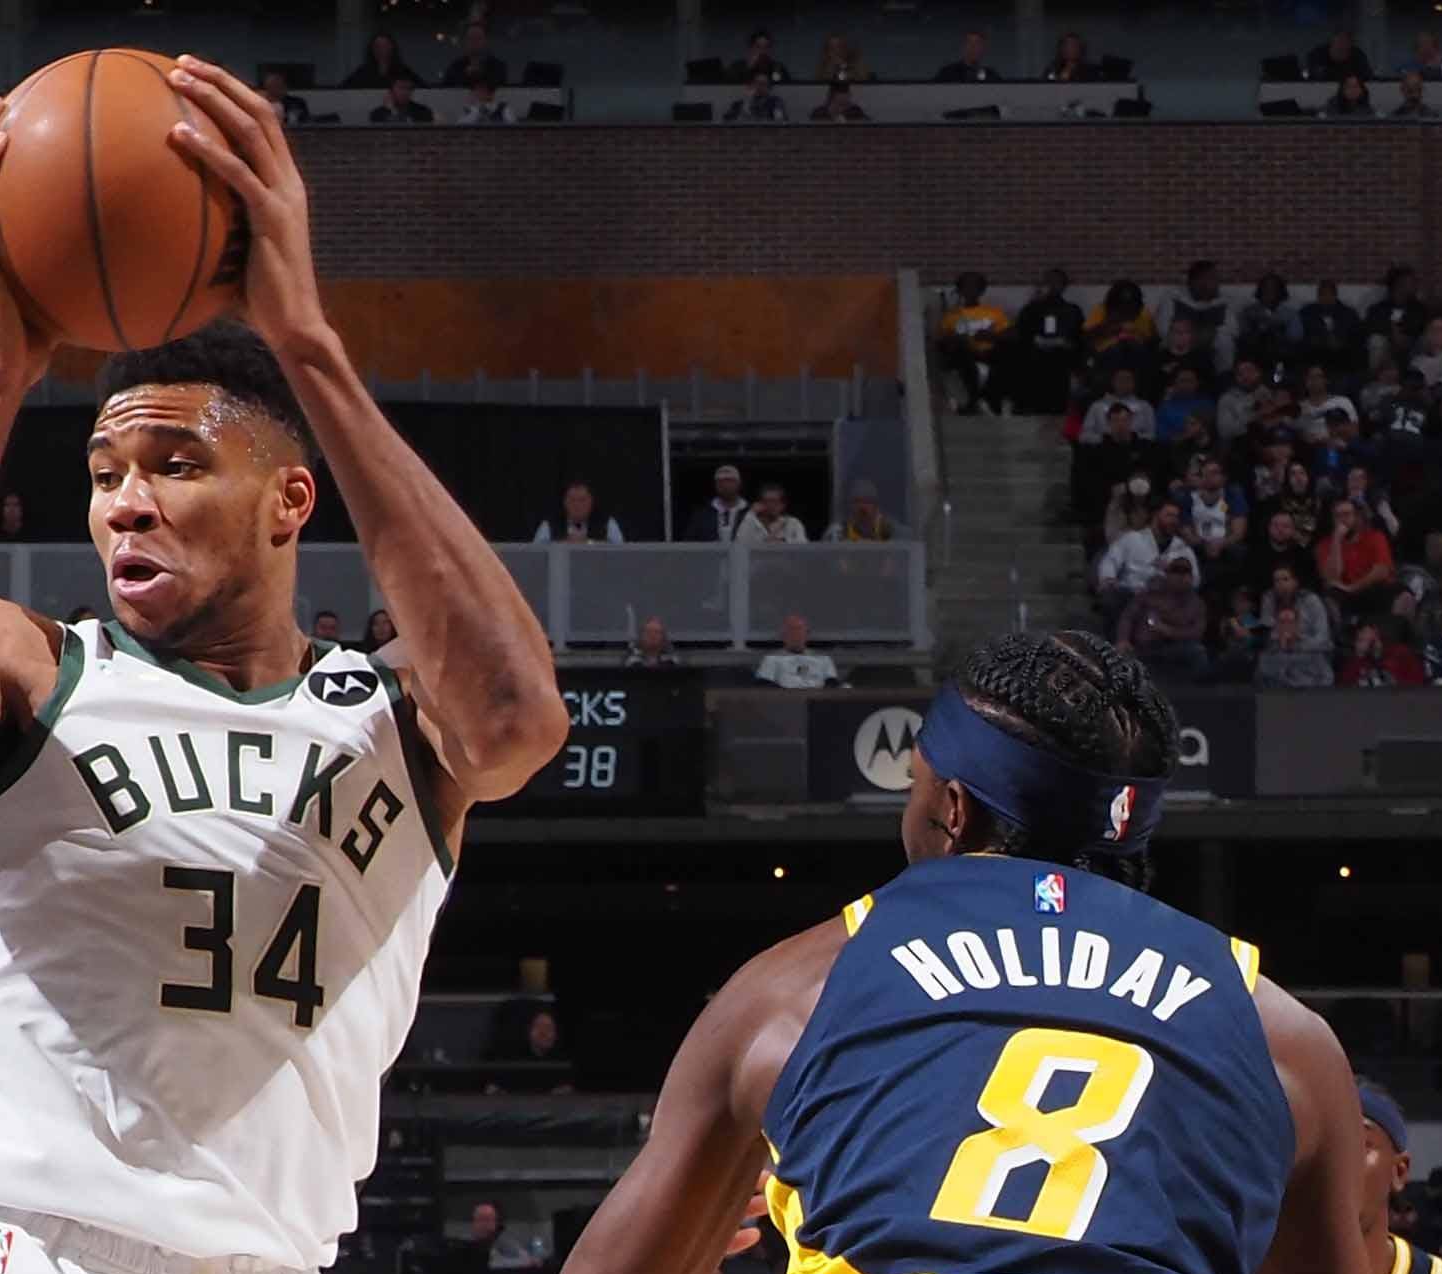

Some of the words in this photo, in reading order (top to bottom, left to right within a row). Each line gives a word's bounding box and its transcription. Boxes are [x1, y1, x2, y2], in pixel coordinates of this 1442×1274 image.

[72, 730, 405, 875] BUCKS
[562, 744, 618, 789] 38
[160, 865, 325, 1028] 34
[890, 926, 1212, 1022] HOLIDAY
[928, 1027, 1156, 1243] 8
